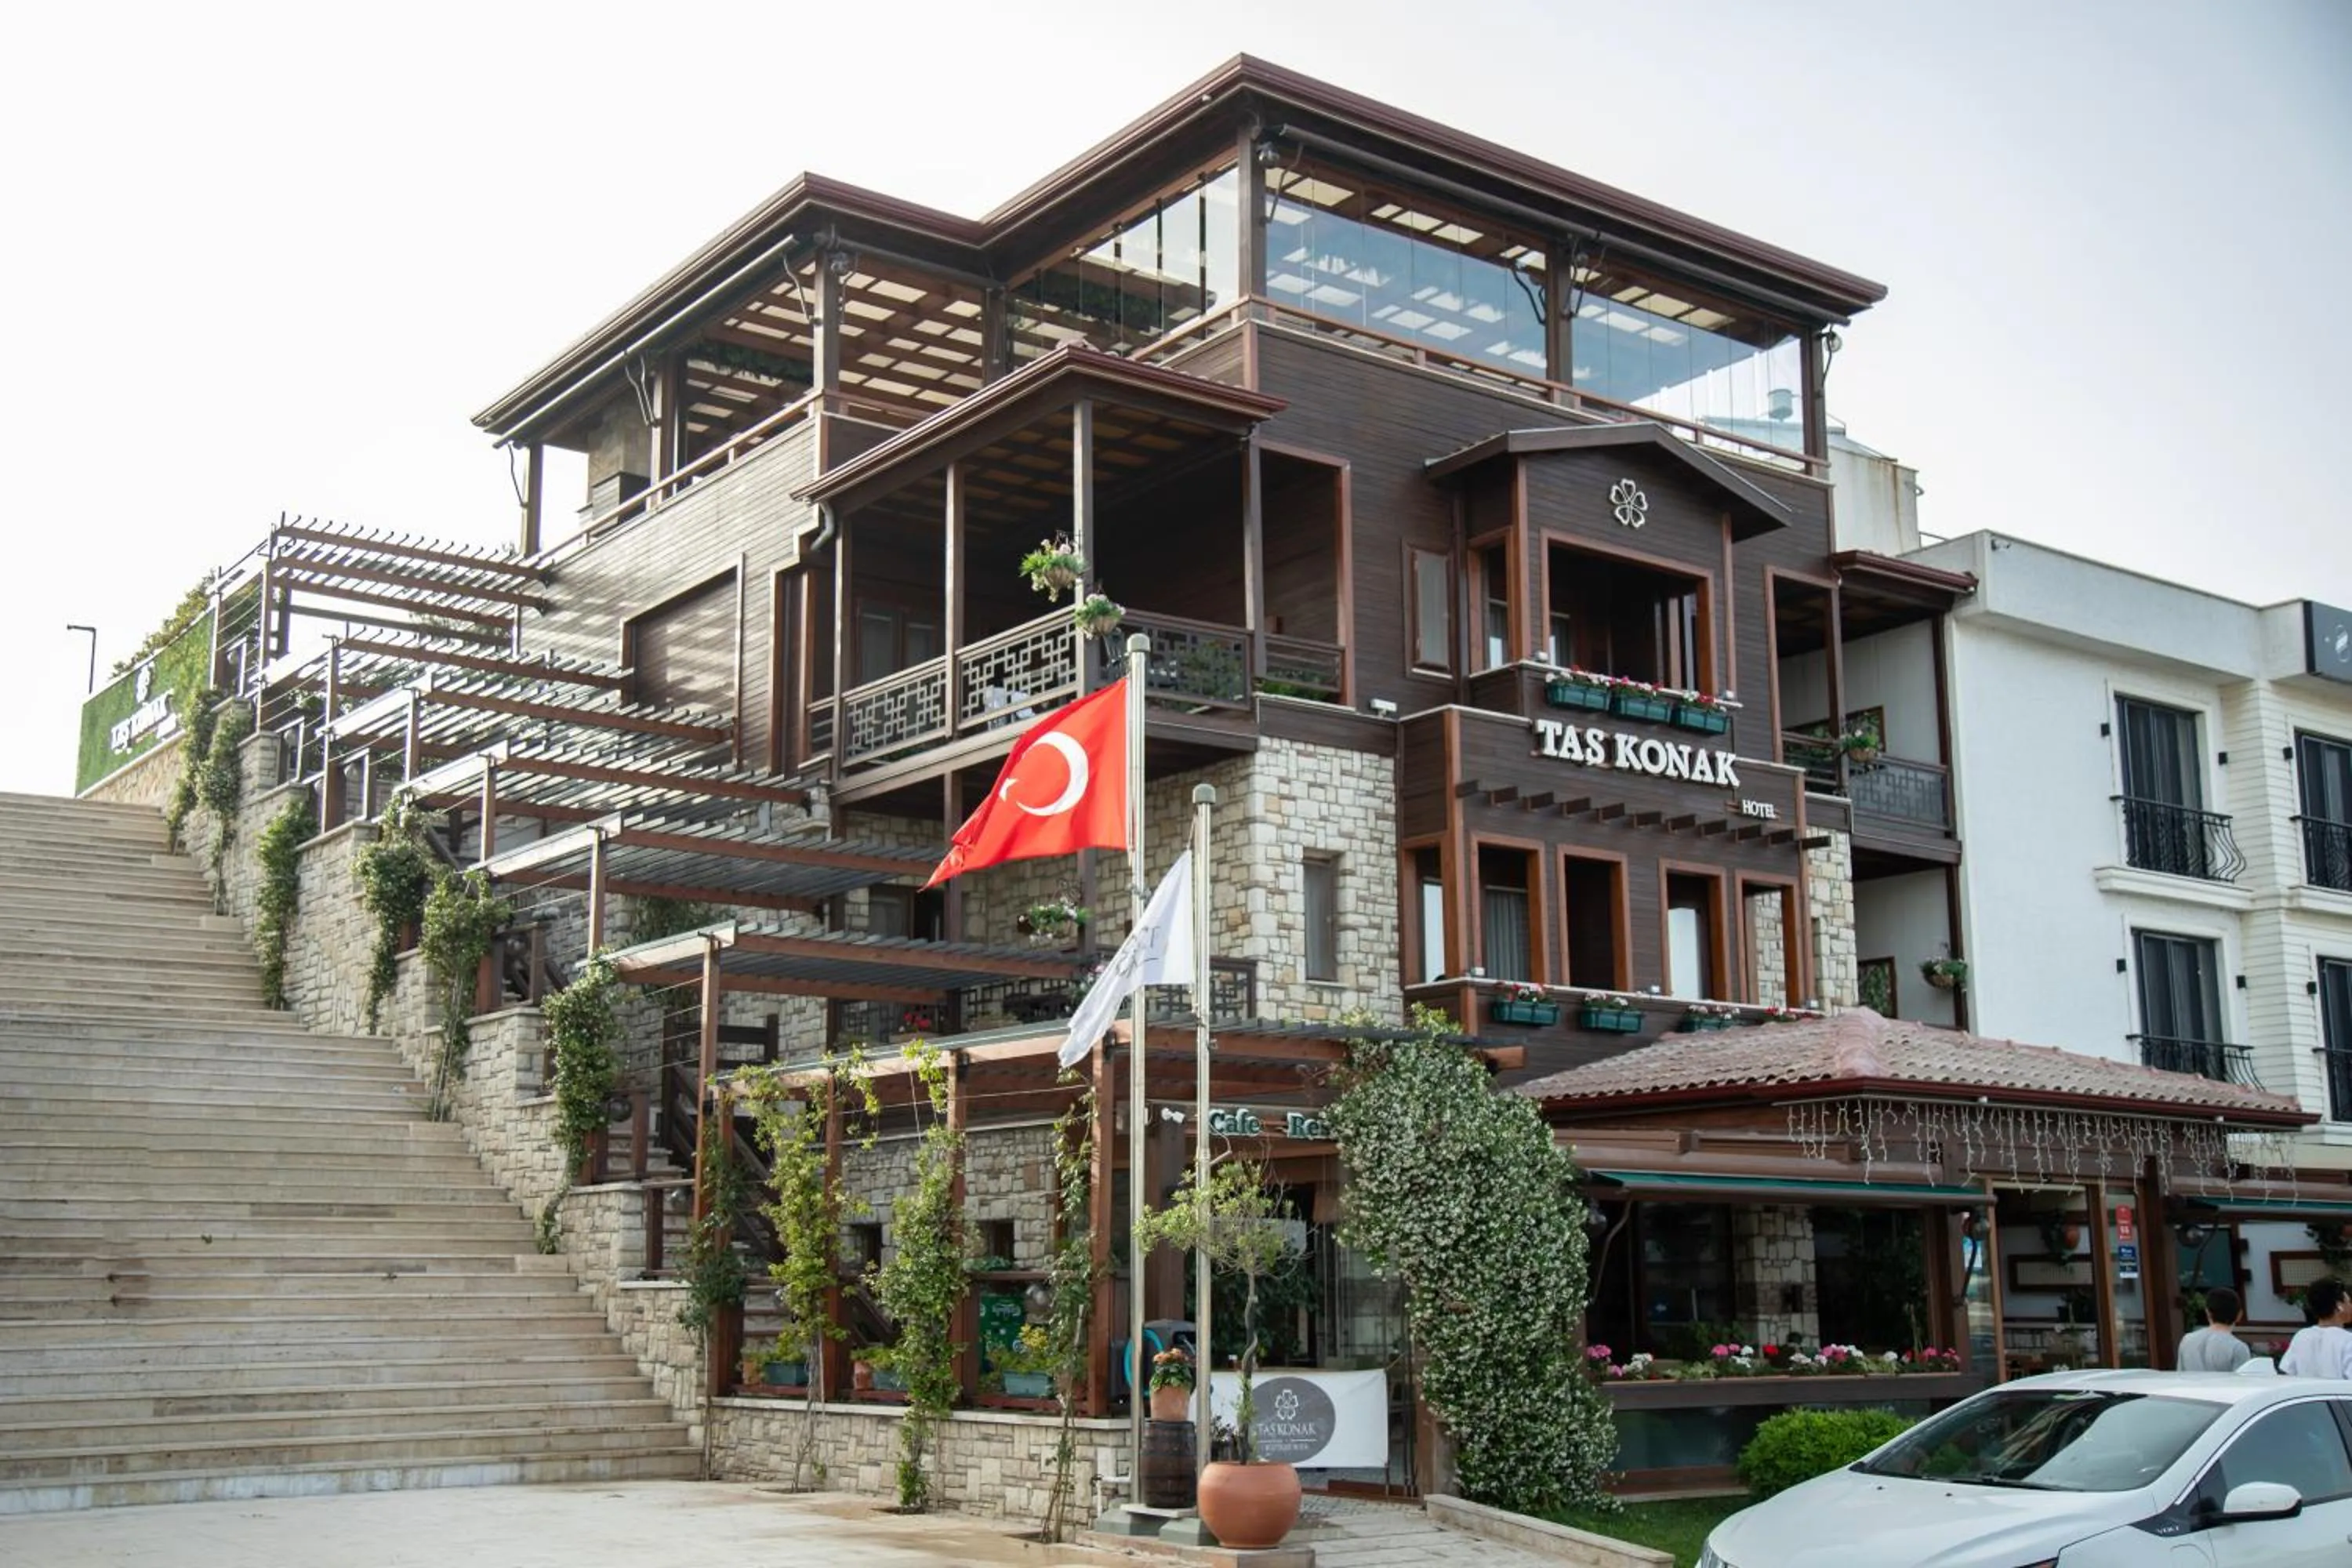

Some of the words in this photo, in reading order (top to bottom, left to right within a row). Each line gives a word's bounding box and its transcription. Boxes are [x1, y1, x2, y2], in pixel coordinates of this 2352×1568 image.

[1534, 719, 1605, 766] TAŞ
[1613, 732, 1740, 787] KONAK
[1741, 798, 1777, 819] HOTEL
[1208, 1108, 1261, 1137] Cafe
[1277, 1421, 1317, 1436] KONAK
